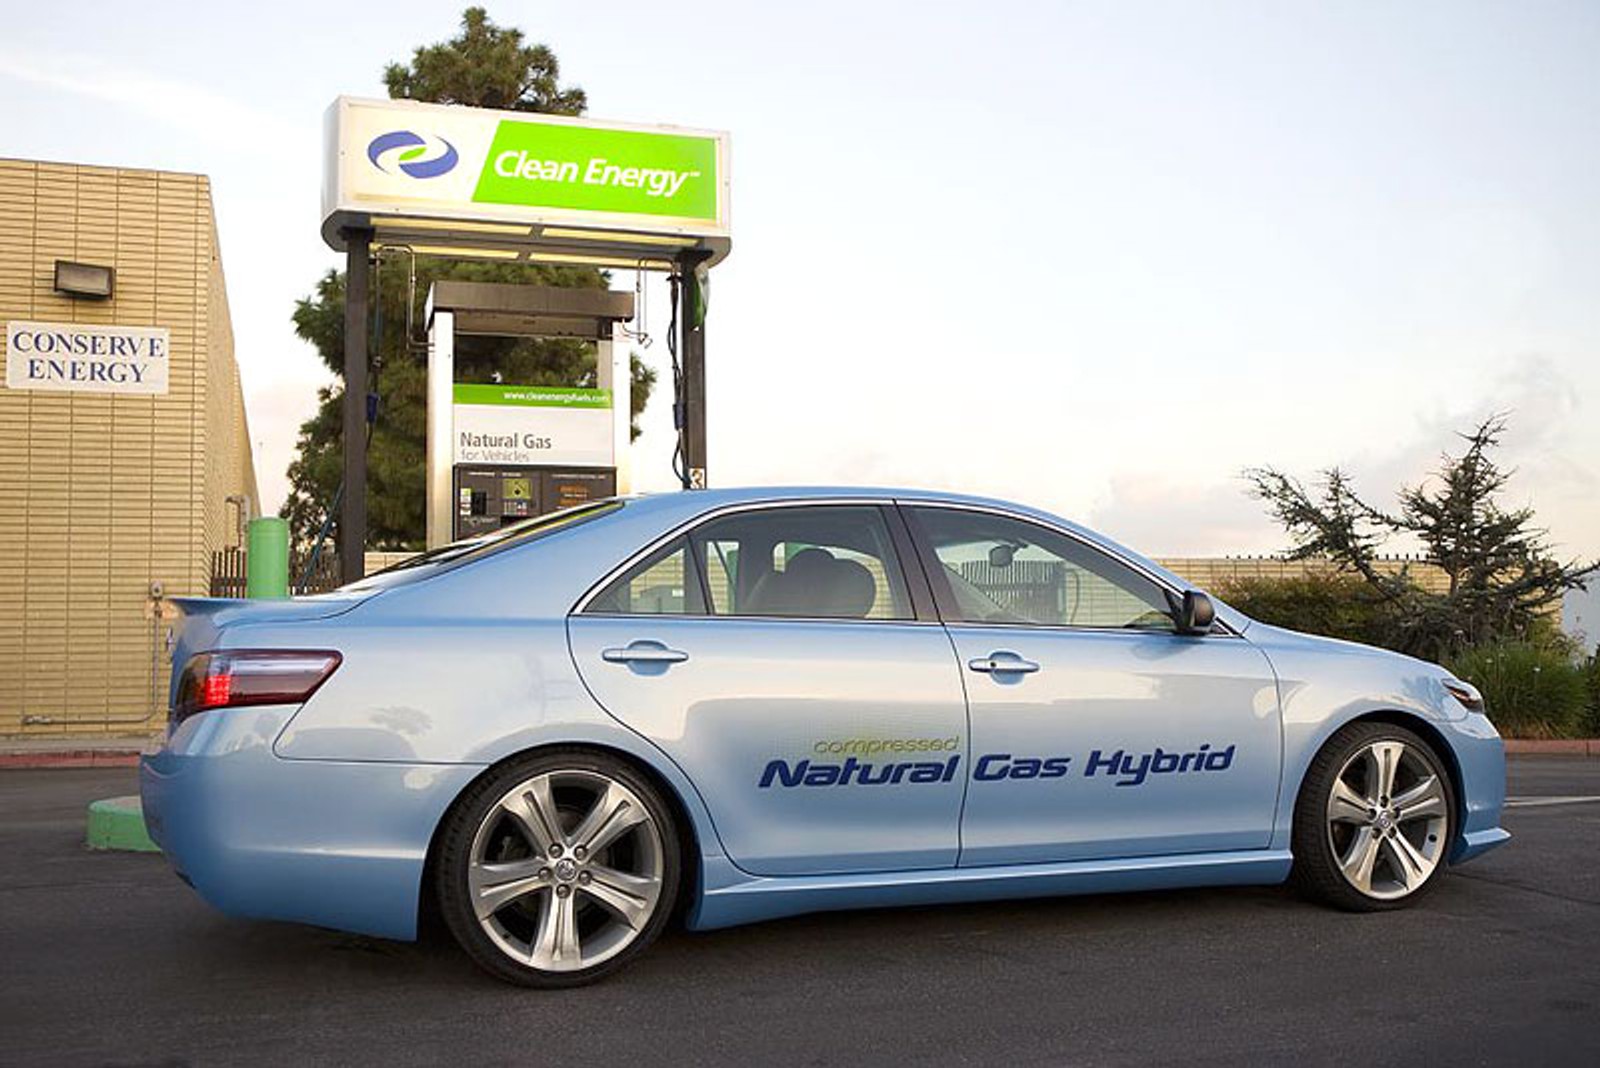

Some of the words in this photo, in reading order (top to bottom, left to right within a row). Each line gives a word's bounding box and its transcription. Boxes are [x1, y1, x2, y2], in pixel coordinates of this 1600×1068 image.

[494, 150, 577, 183] Clean
[13, 331, 165, 358] CONSERVE
[28, 359, 148, 384] ENERGY
[460, 432, 518, 448] Natural
[523, 434, 552, 450] Gas
[461, 450, 480, 462] for
[482, 450, 530, 463] Vehicles
[814, 735, 960, 756] compressed
[758, 754, 961, 788] Natural
[973, 754, 1071, 781] Gas
[1083, 743, 1236, 787] Hybrid
